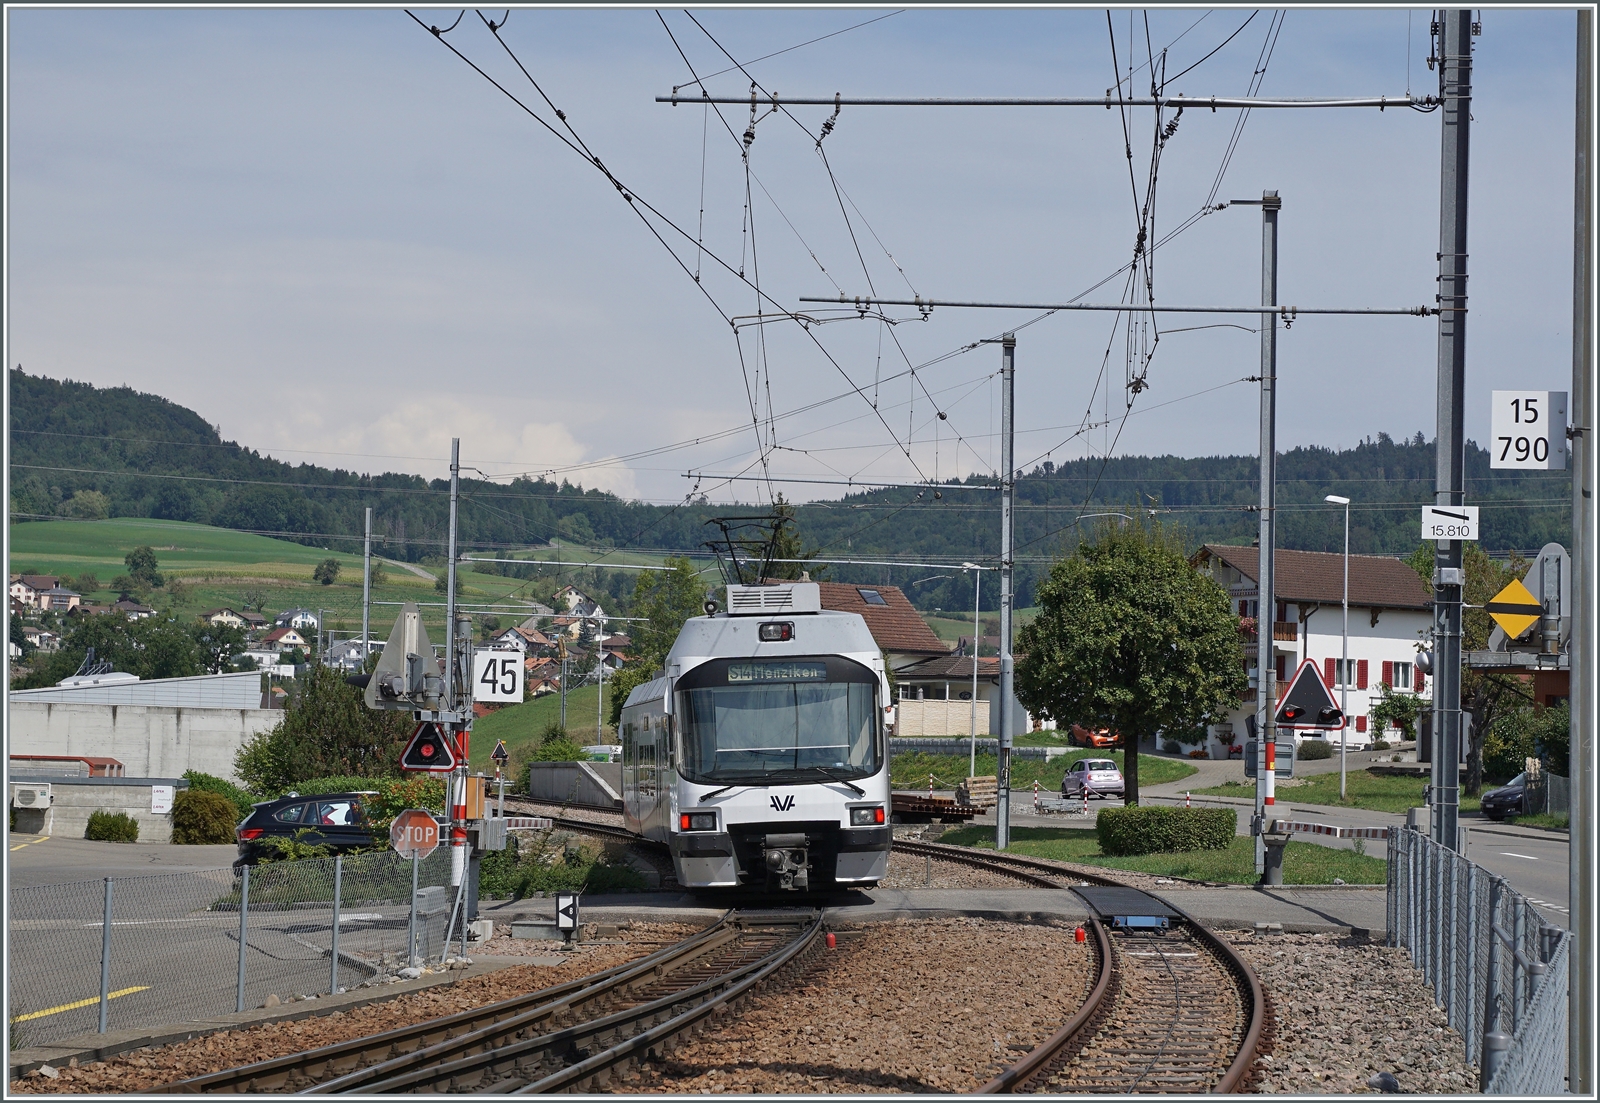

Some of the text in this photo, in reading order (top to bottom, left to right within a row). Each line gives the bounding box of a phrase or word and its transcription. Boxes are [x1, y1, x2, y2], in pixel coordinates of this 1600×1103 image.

[1510, 398, 1539, 424] 15
[1498, 436, 1549, 462] 790
[1430, 525, 1470, 537] 15.810
[480, 658, 517, 695] 45
[729, 663, 818, 680] S14 Menziken
[396, 825, 434, 843] STOP
